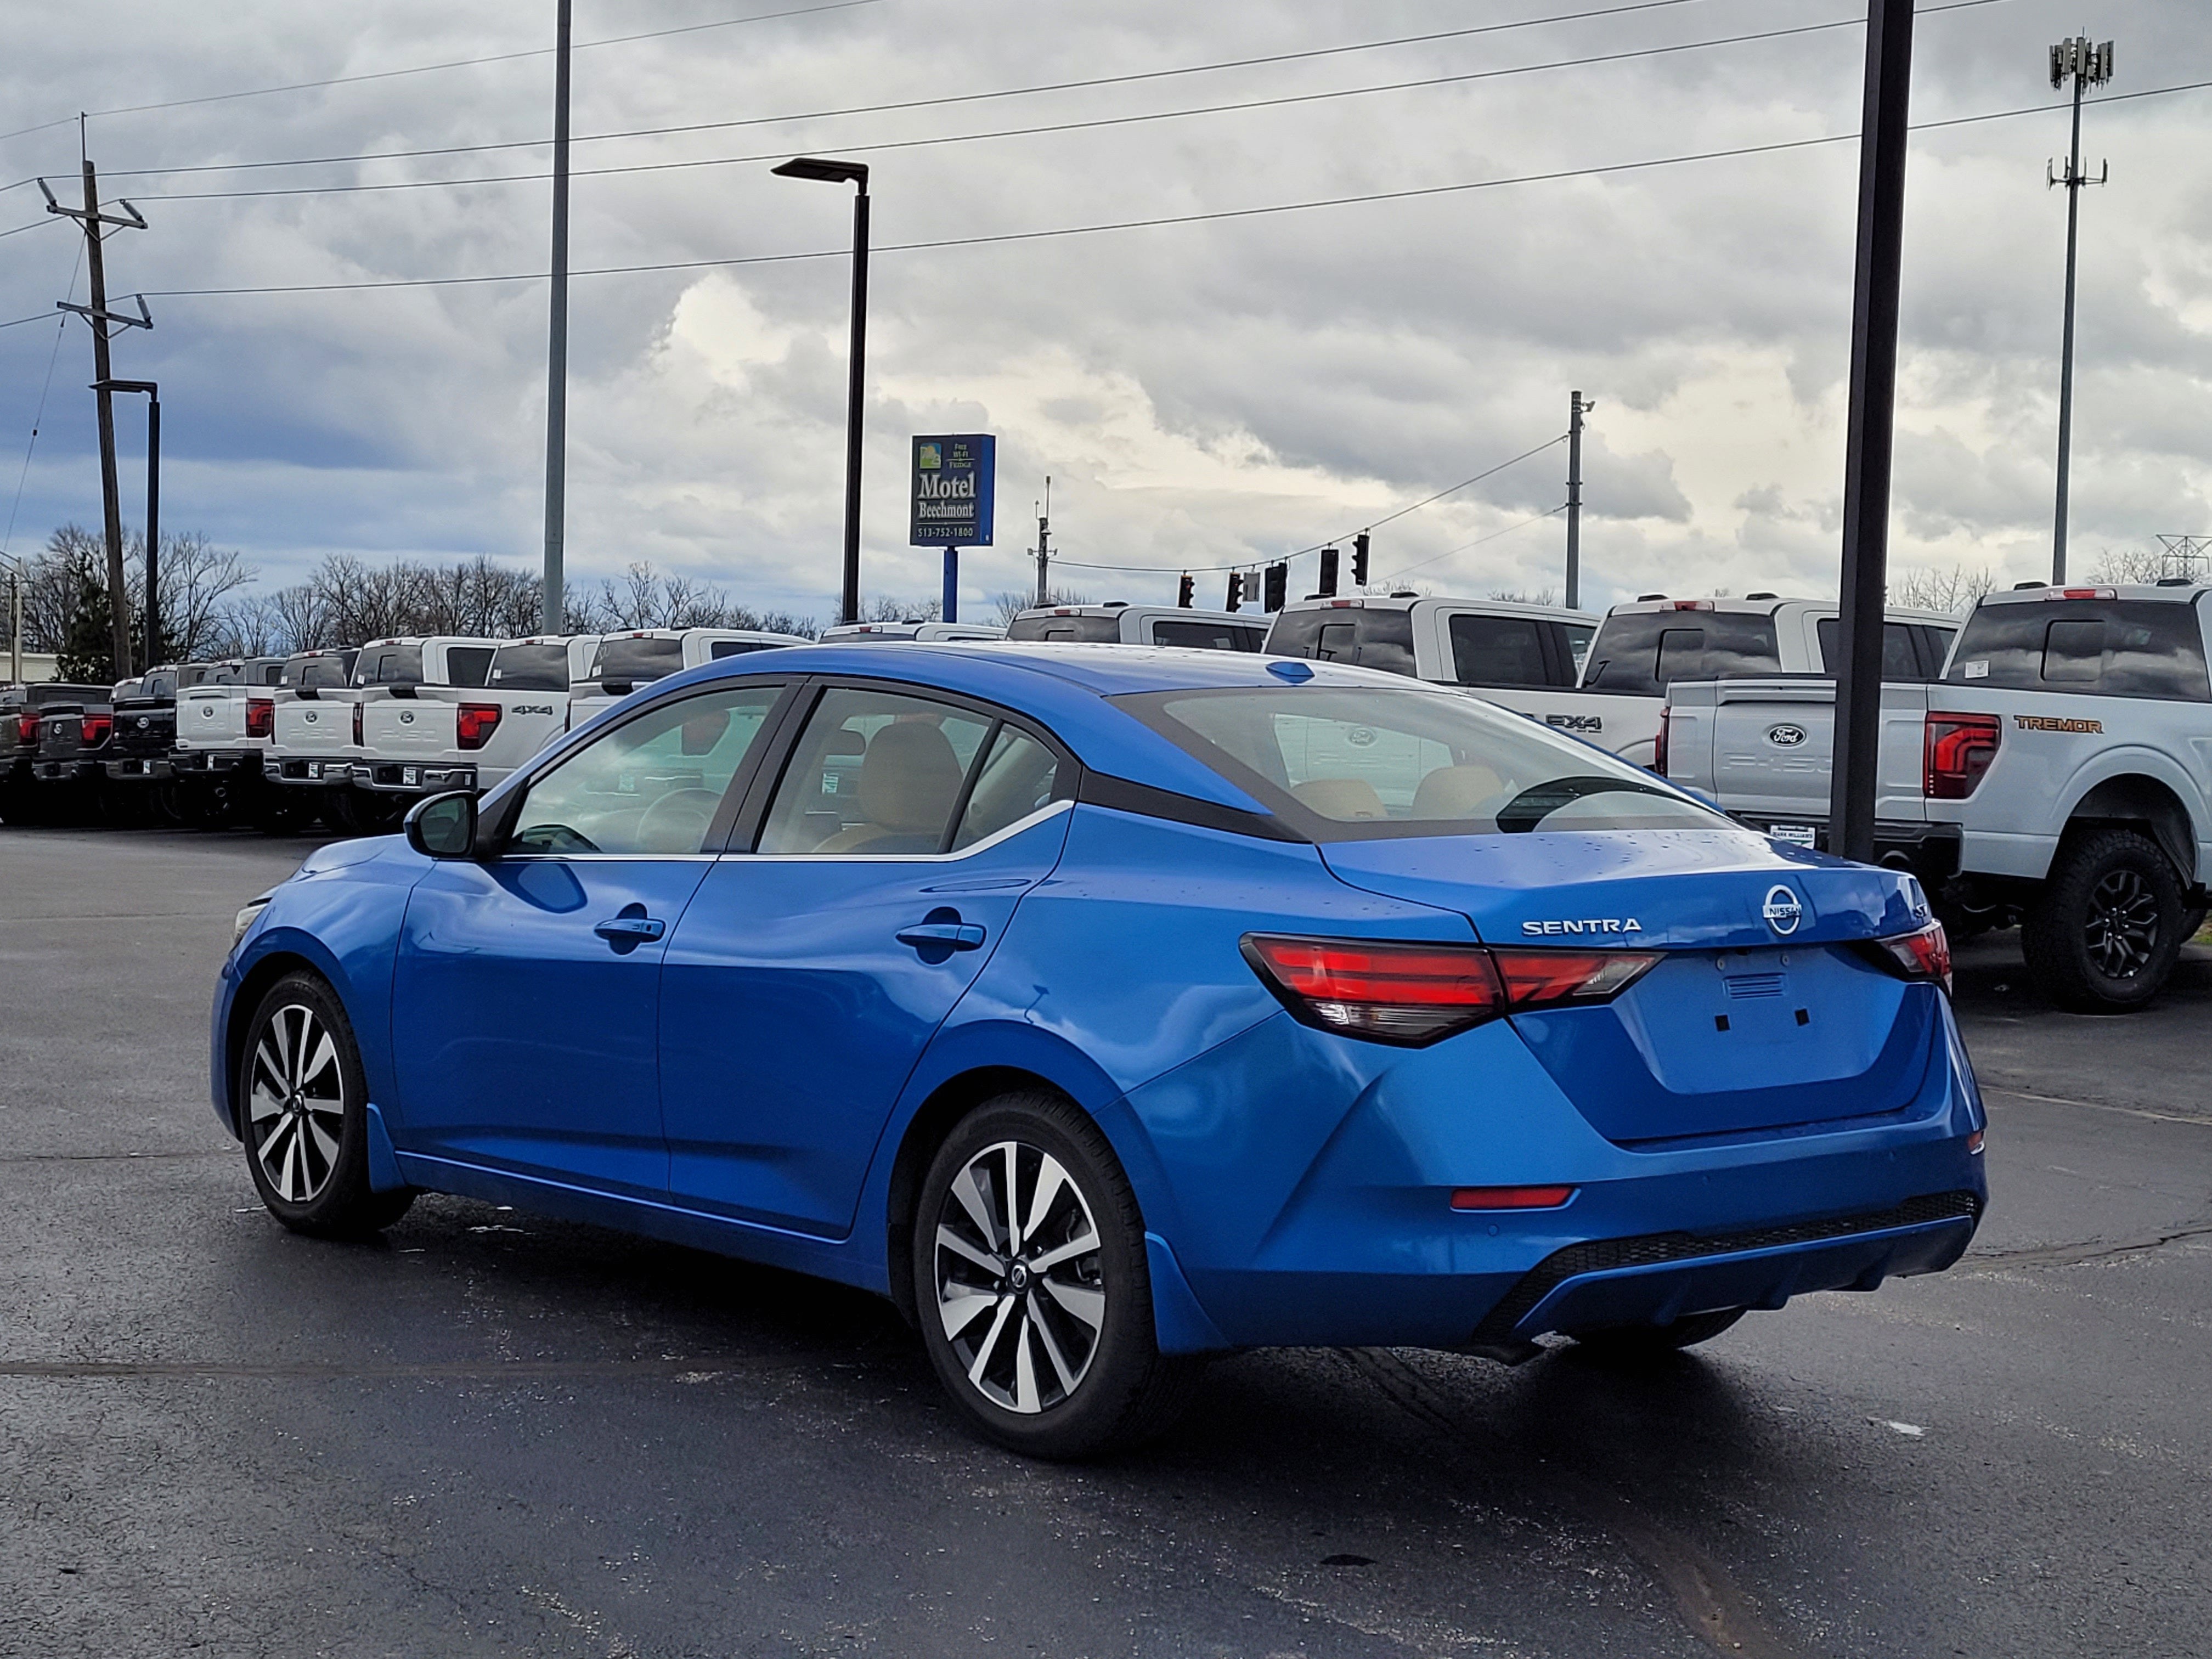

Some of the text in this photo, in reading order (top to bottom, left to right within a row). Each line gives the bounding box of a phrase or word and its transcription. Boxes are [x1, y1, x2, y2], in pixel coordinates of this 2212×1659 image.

[917, 471, 976, 499] Motel
[918, 500, 975, 518] Beechmont
[2013, 715, 2104, 733] TREMOR
[1774, 727, 1799, 742] Ford
[1769, 907, 1801, 916] NISSAN
[1522, 918, 1643, 935] SENTRA
